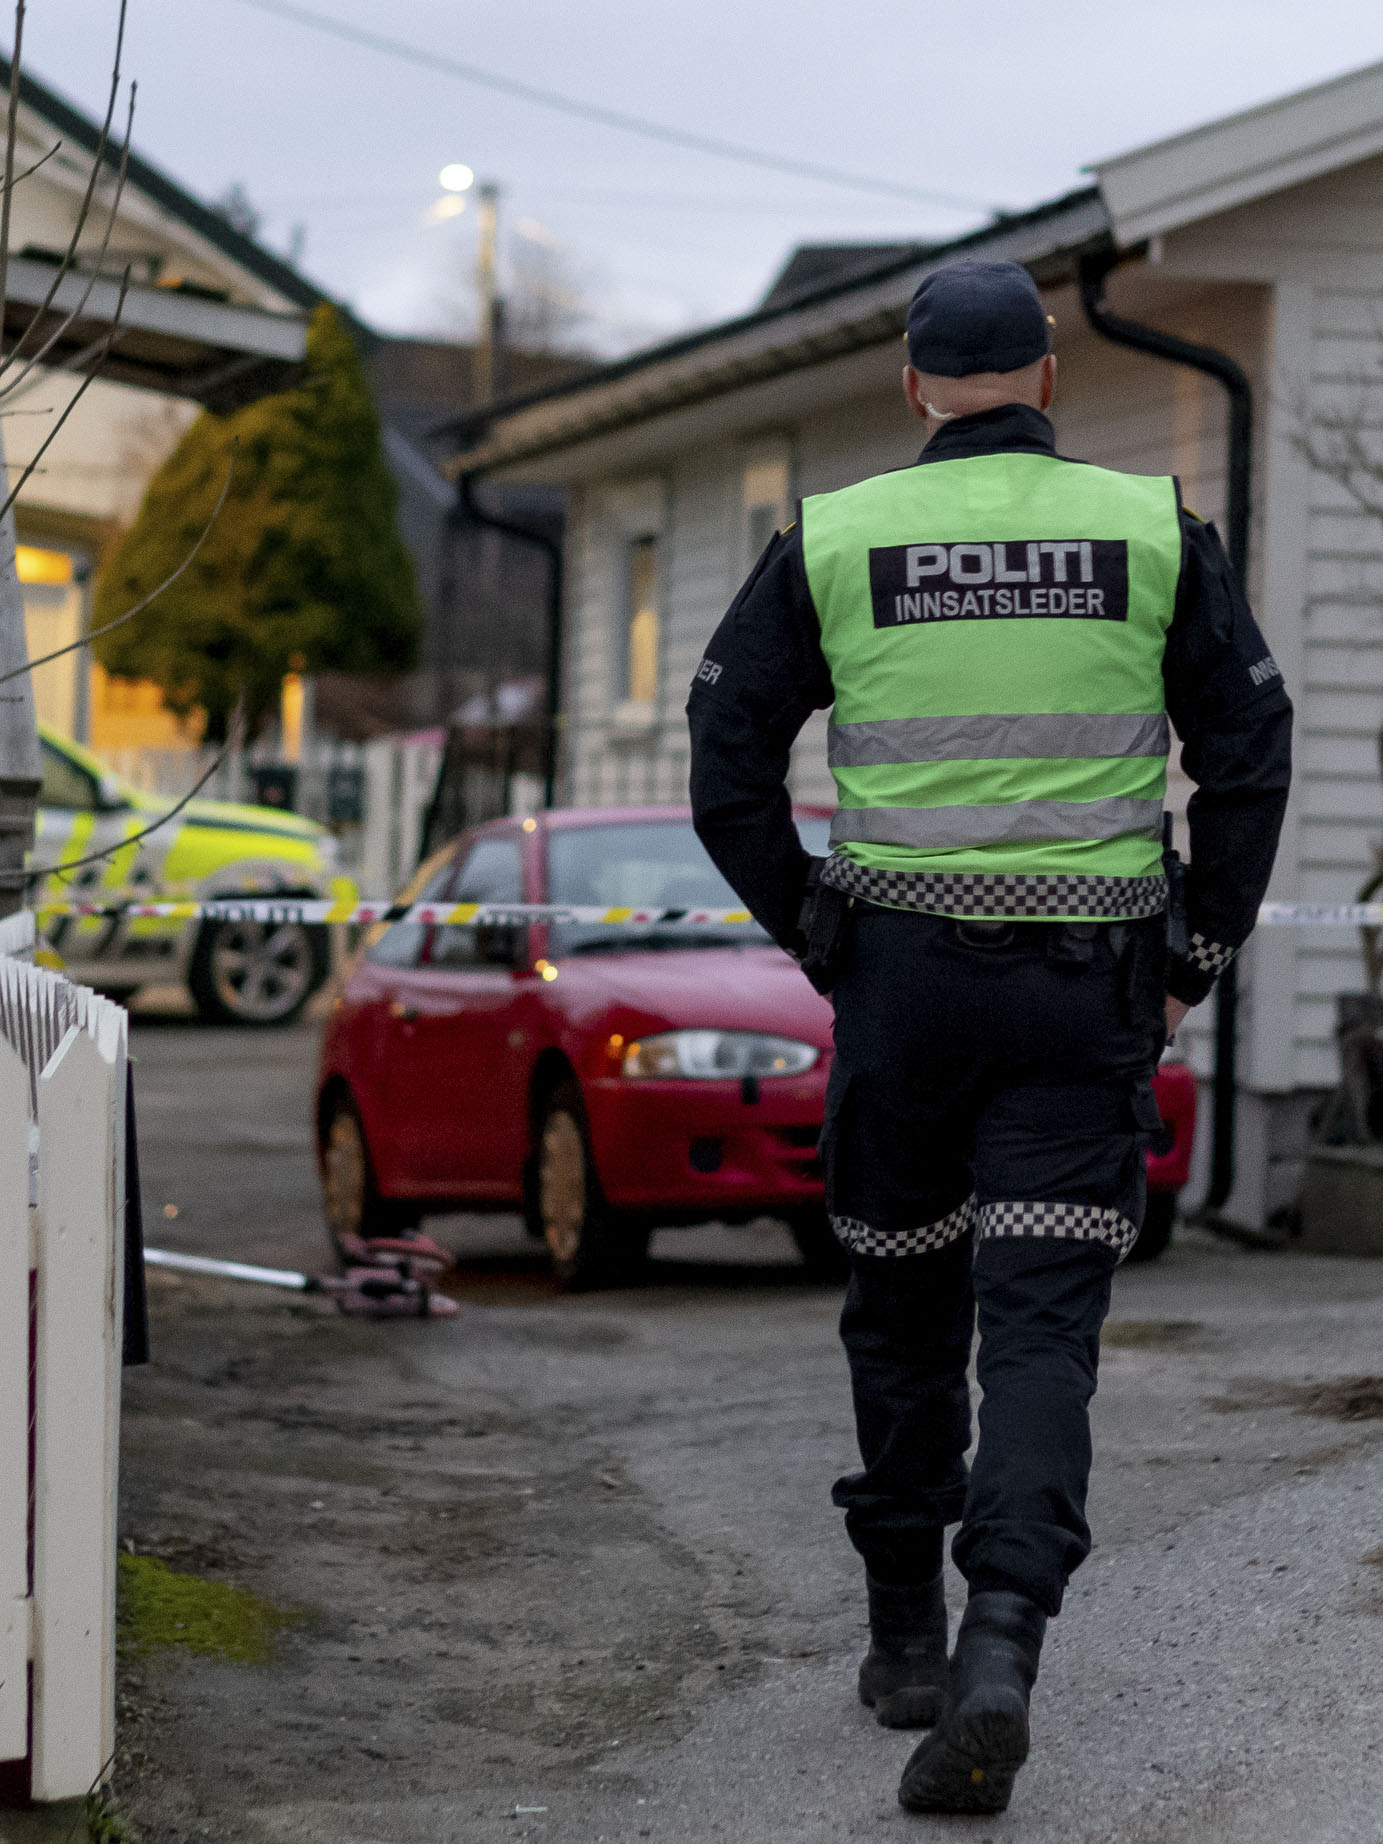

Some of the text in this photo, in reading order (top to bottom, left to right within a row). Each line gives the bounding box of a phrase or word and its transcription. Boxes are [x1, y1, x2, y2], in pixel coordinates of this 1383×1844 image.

[906, 541, 1093, 587] POLITI
[895, 588, 1105, 622] INNSATSLEDER
[697, 659, 723, 685] ER
